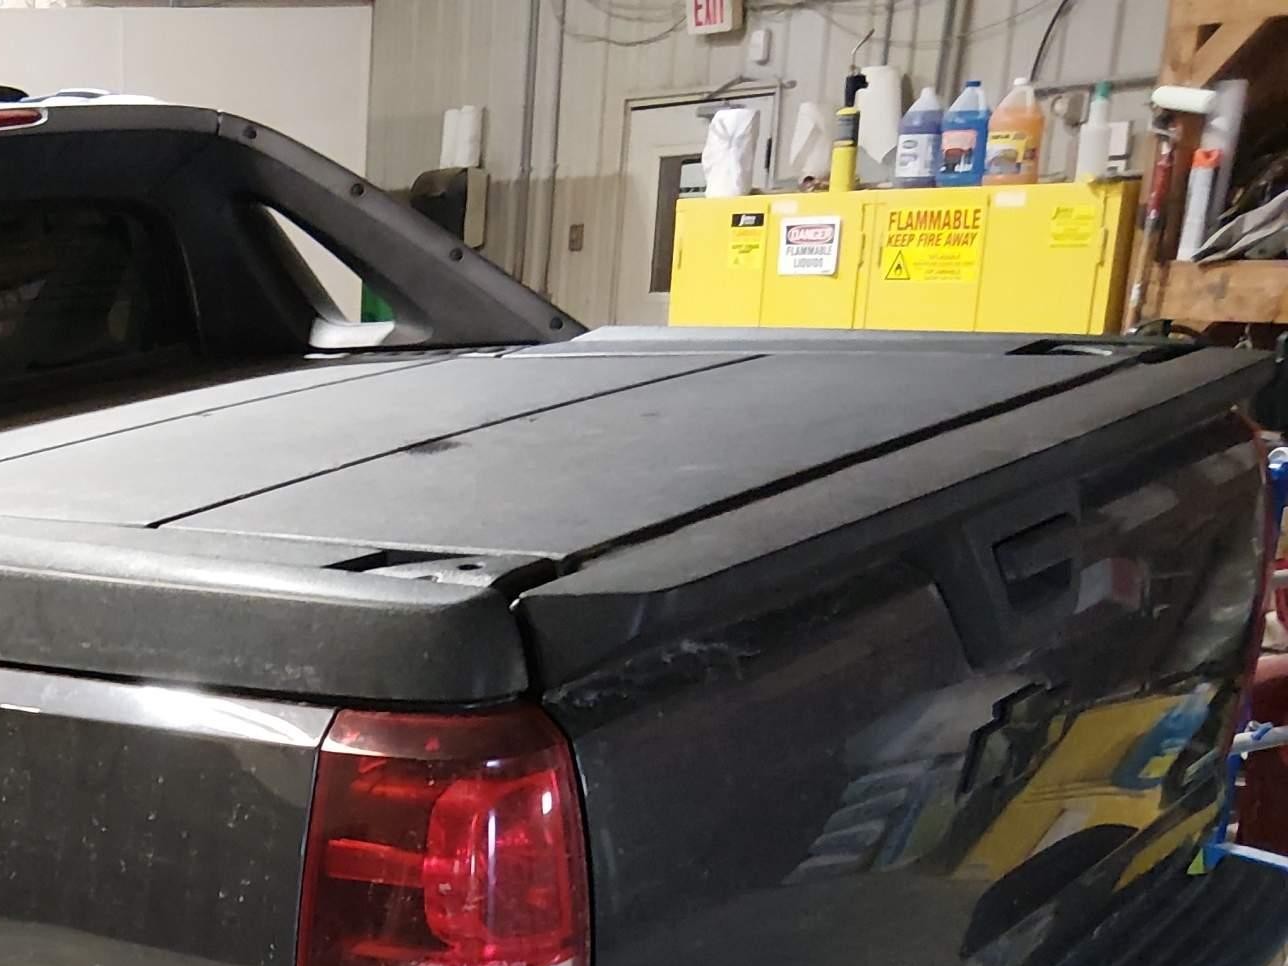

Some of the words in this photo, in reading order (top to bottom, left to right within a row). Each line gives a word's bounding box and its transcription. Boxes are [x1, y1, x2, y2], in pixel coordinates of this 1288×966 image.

[888, 208, 981, 231] FLAMMABLE
[887, 233, 915, 247] KEEP
[917, 232, 943, 247] FIRE
[943, 232, 977, 247] AWAY
[785, 245, 832, 256] FLAMMABLE
